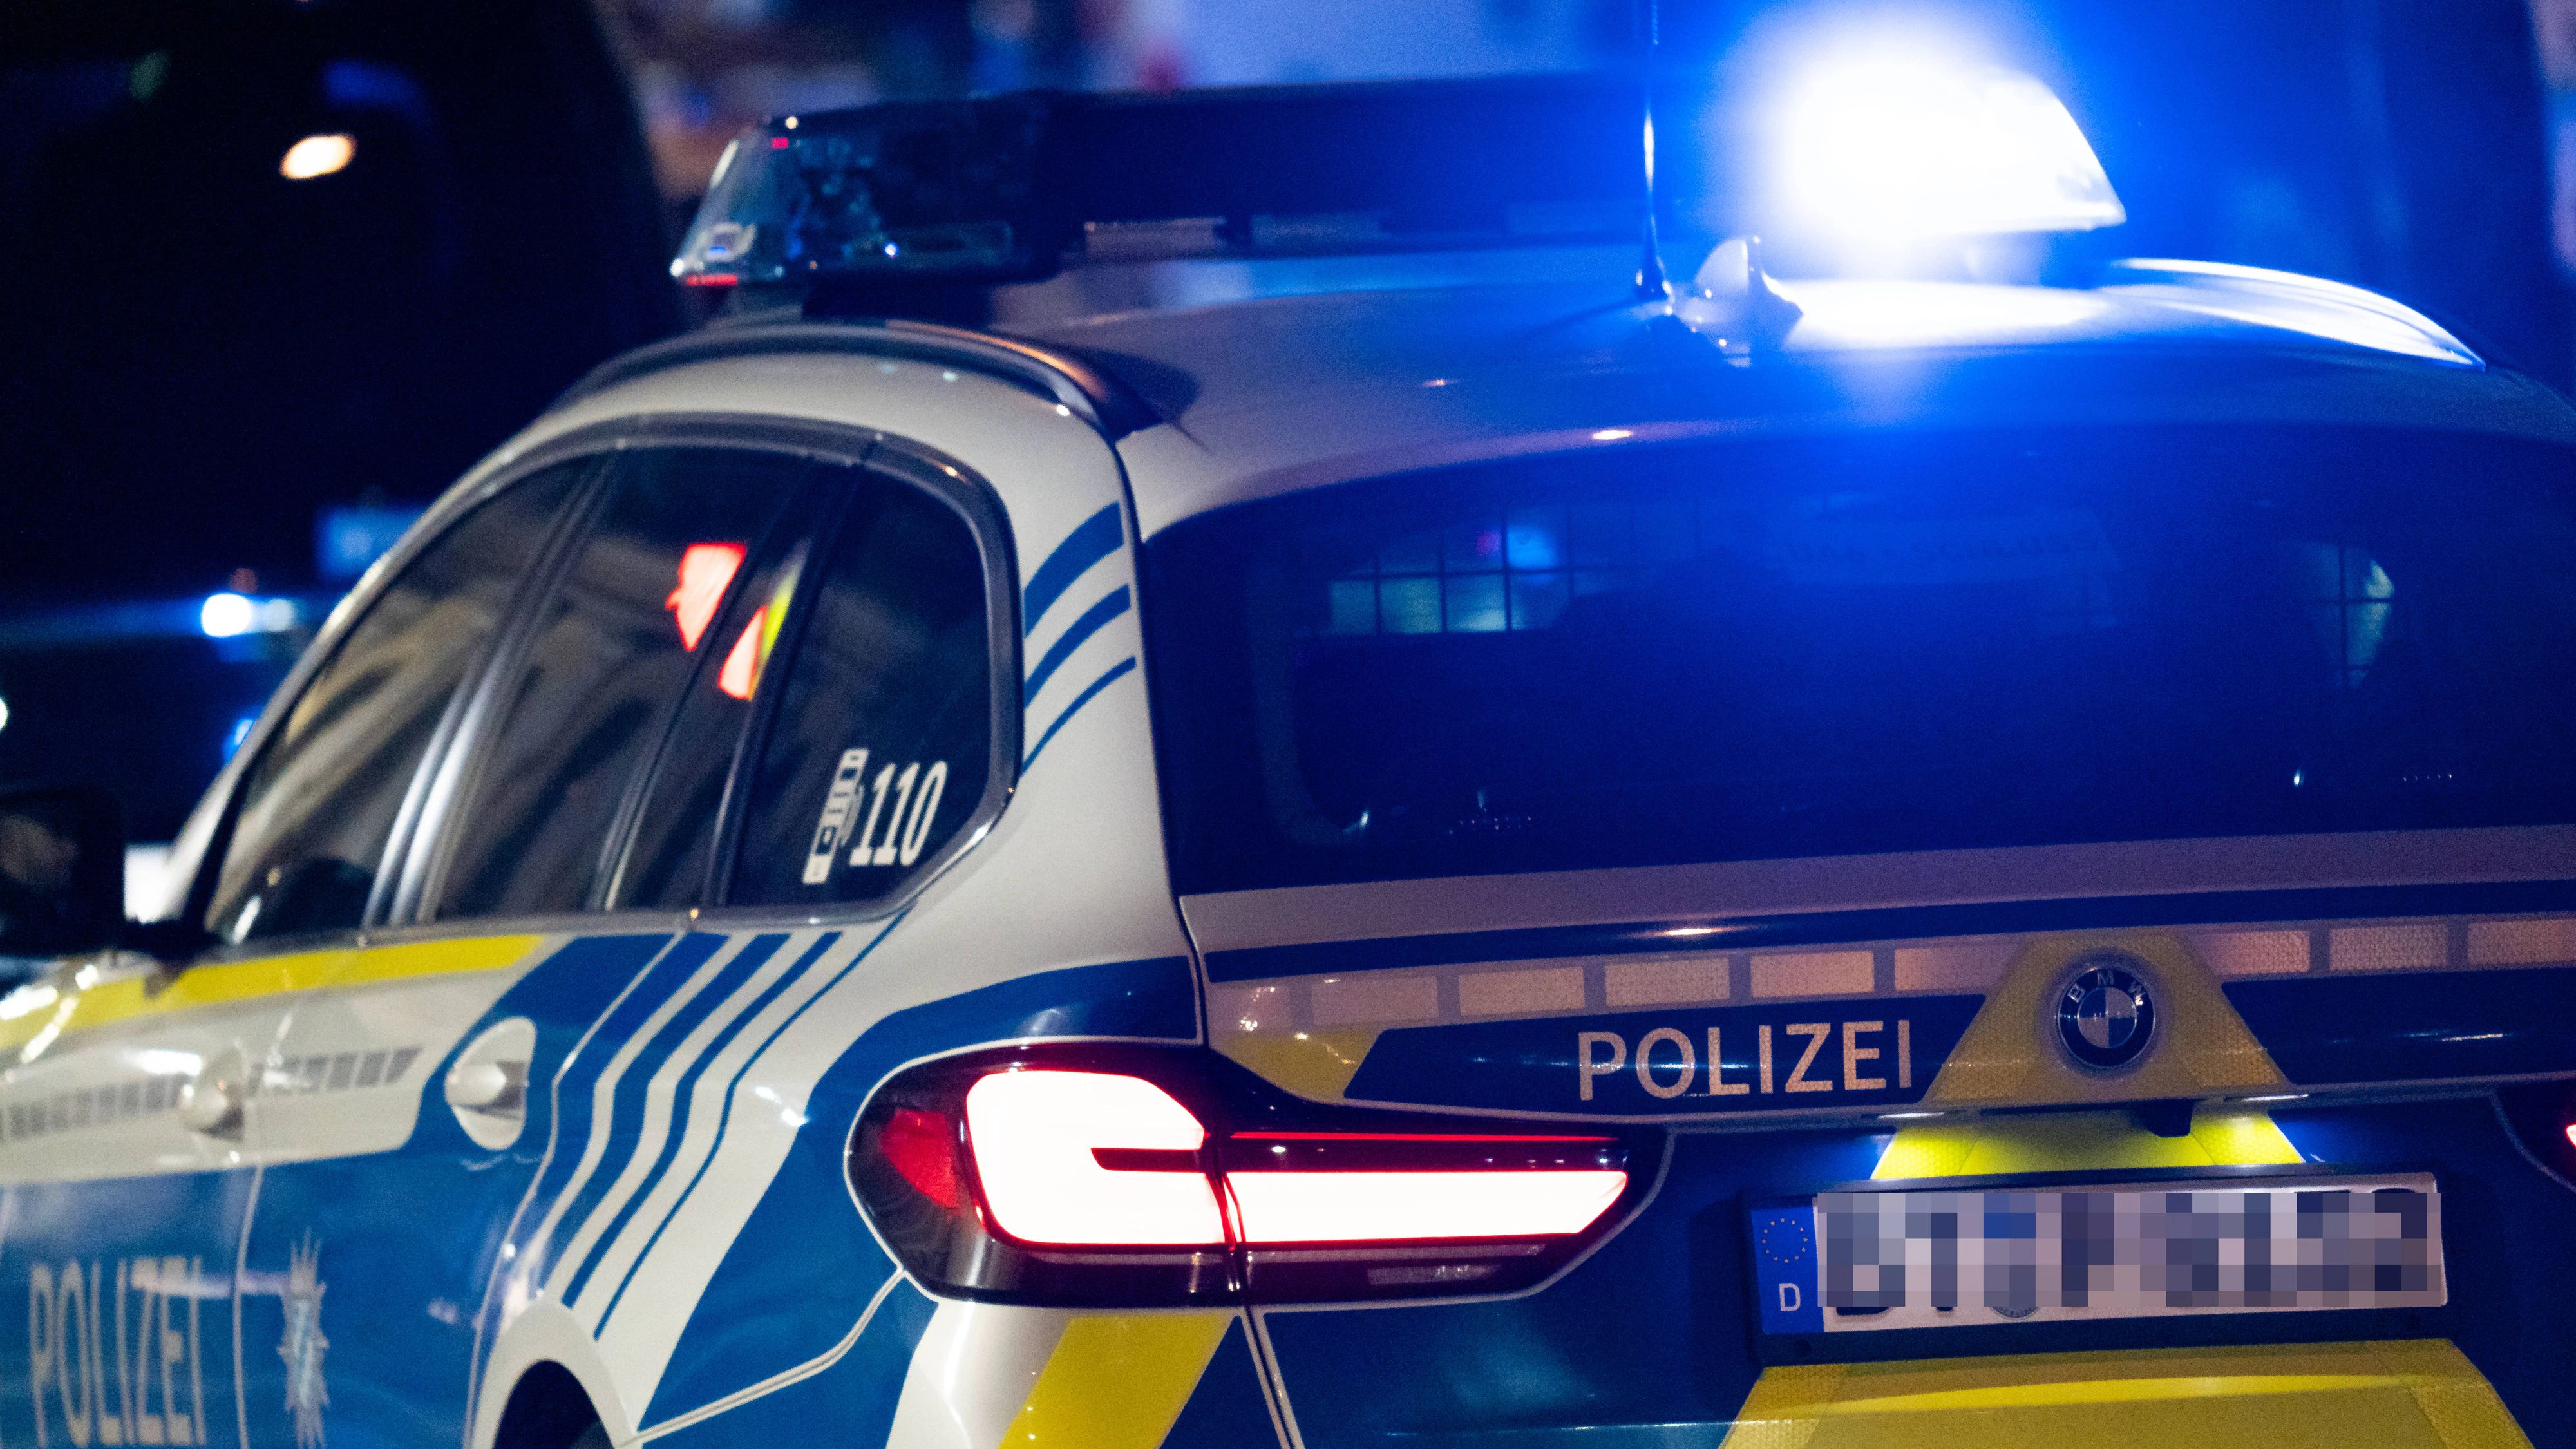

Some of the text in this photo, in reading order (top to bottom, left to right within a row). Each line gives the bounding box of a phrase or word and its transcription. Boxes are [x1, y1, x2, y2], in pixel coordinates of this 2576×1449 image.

[848, 760, 948, 866] 110
[2067, 970, 2146, 1006] BMW
[1578, 1019, 1911, 1101] POLIZEI
[1779, 1283, 1801, 1311] D
[29, 1256, 206, 1448] POLIZEI
